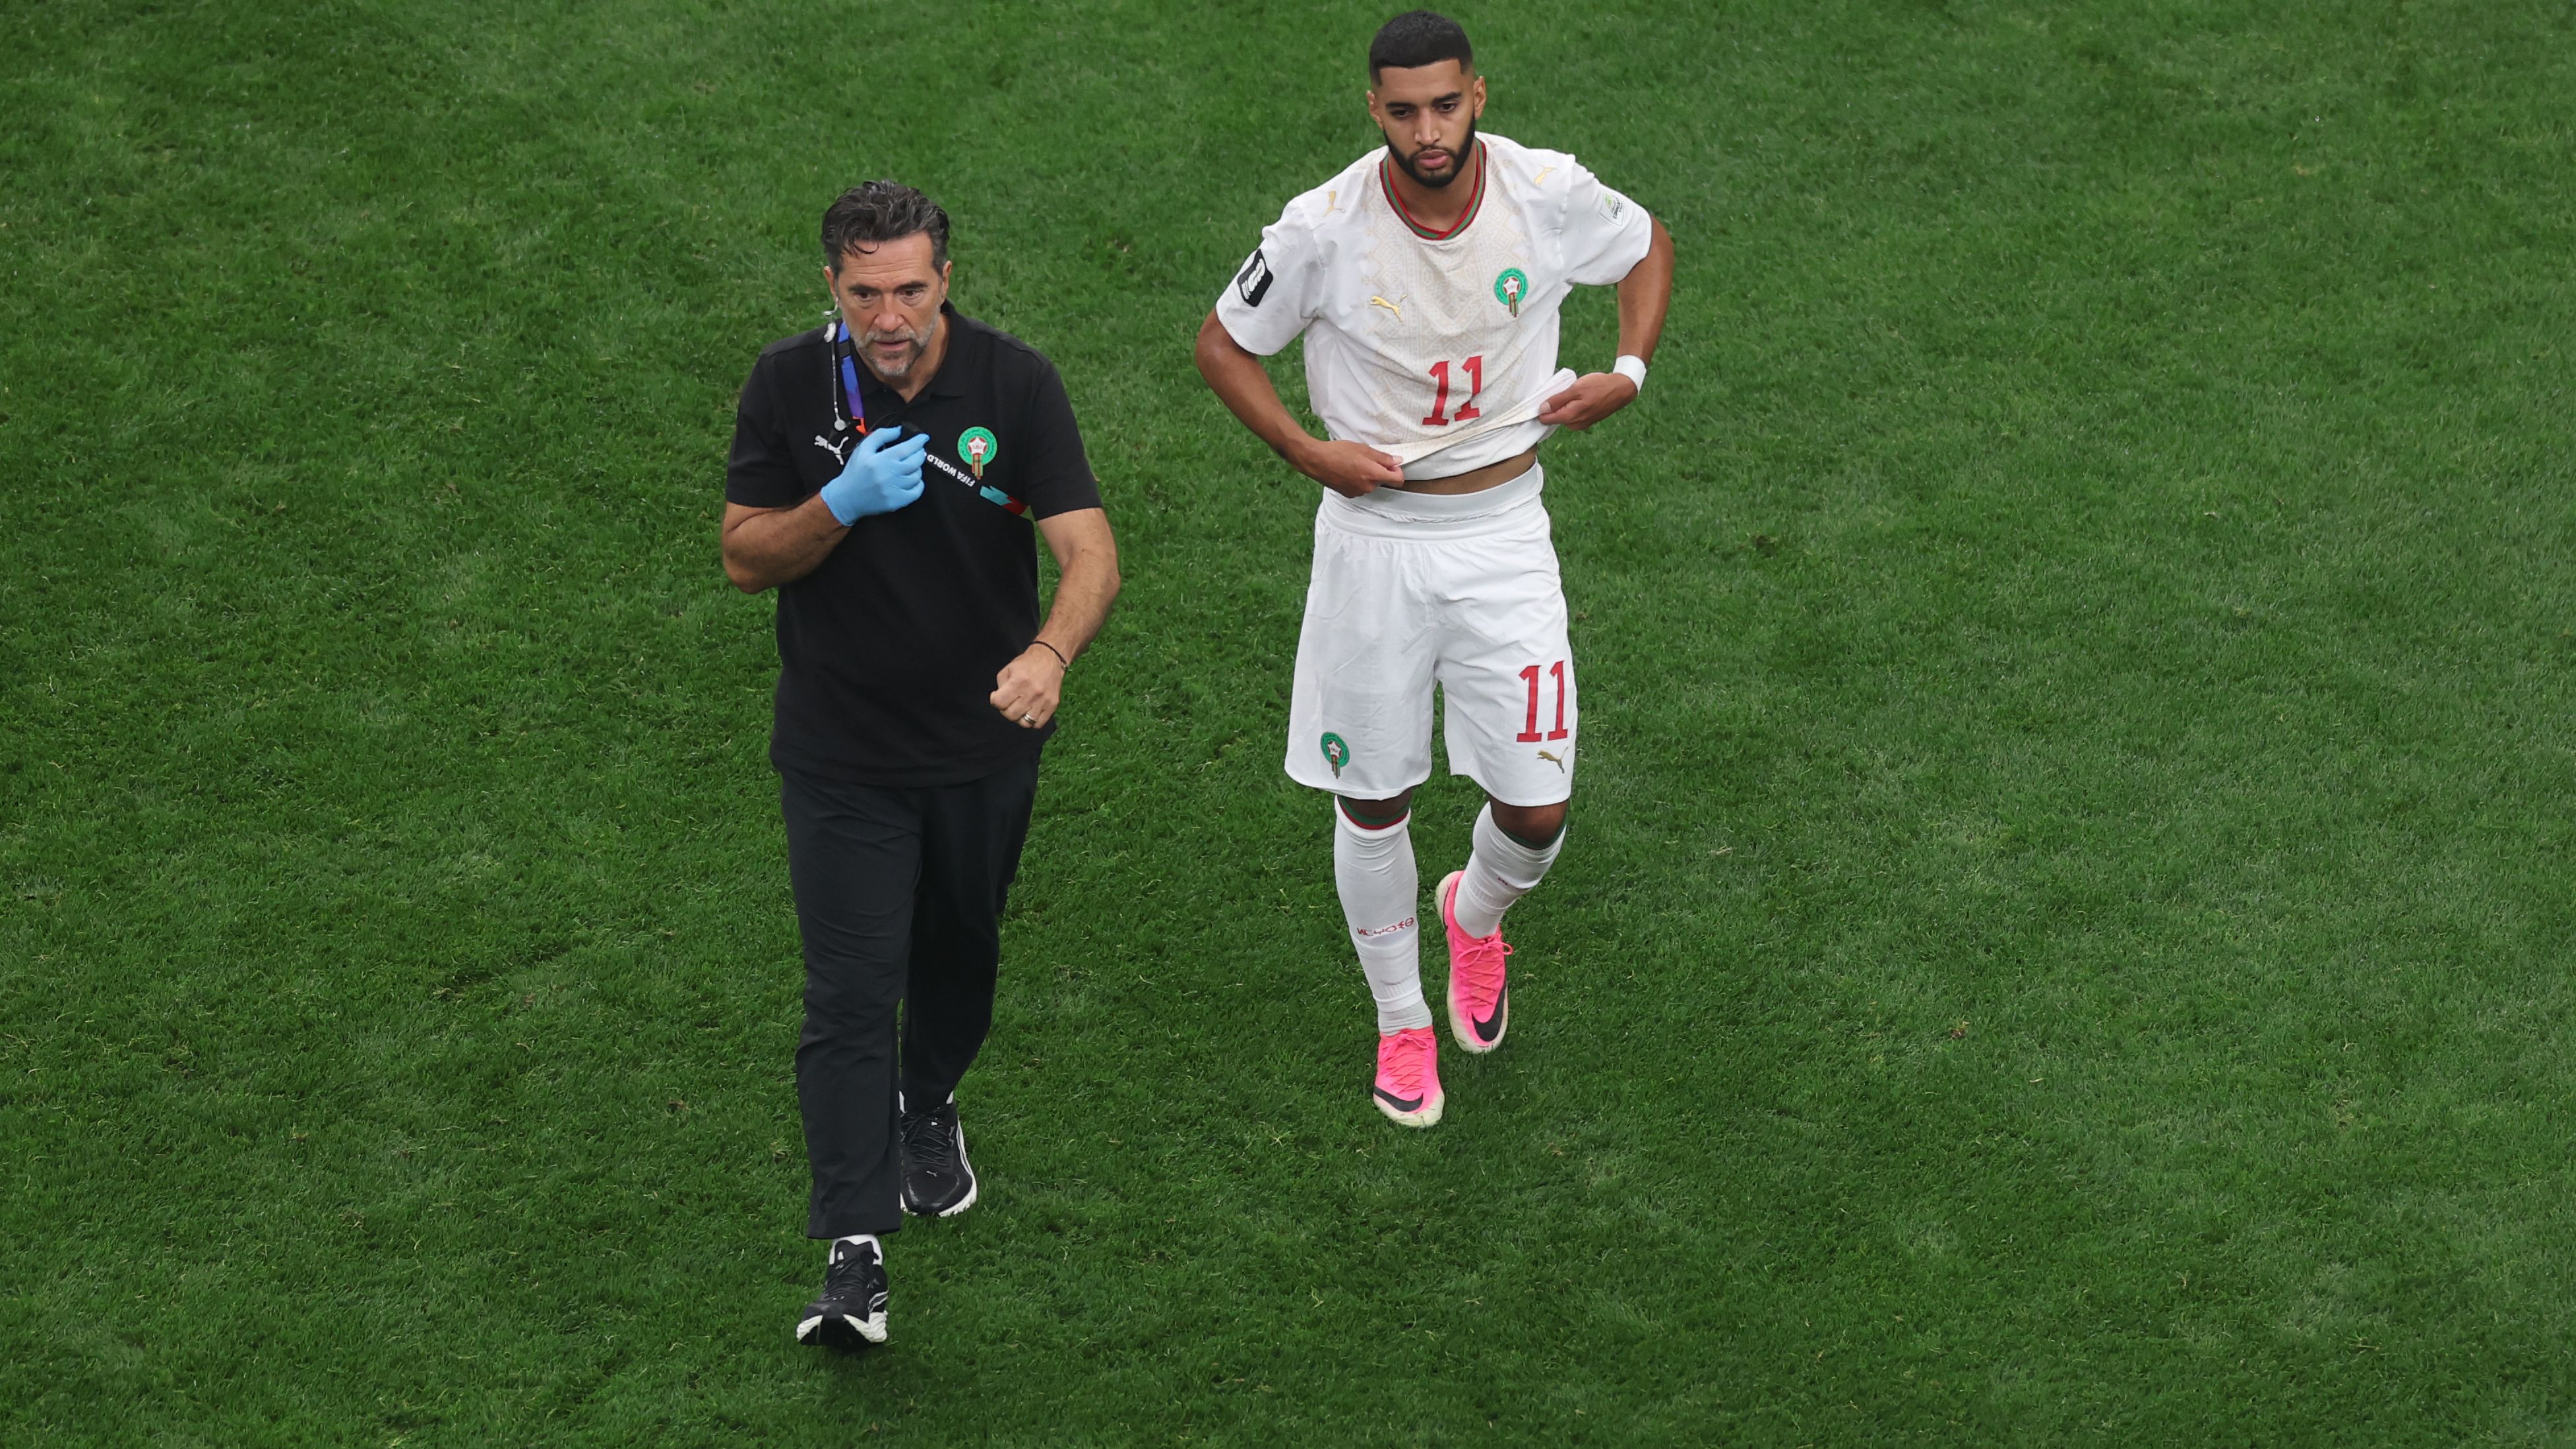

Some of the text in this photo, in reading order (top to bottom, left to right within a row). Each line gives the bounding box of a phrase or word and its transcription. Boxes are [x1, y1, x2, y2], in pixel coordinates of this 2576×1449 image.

[1422, 355, 1483, 426] 11
[927, 454, 976, 487] FIFA WORLD
[1517, 660, 1568, 743] 11
